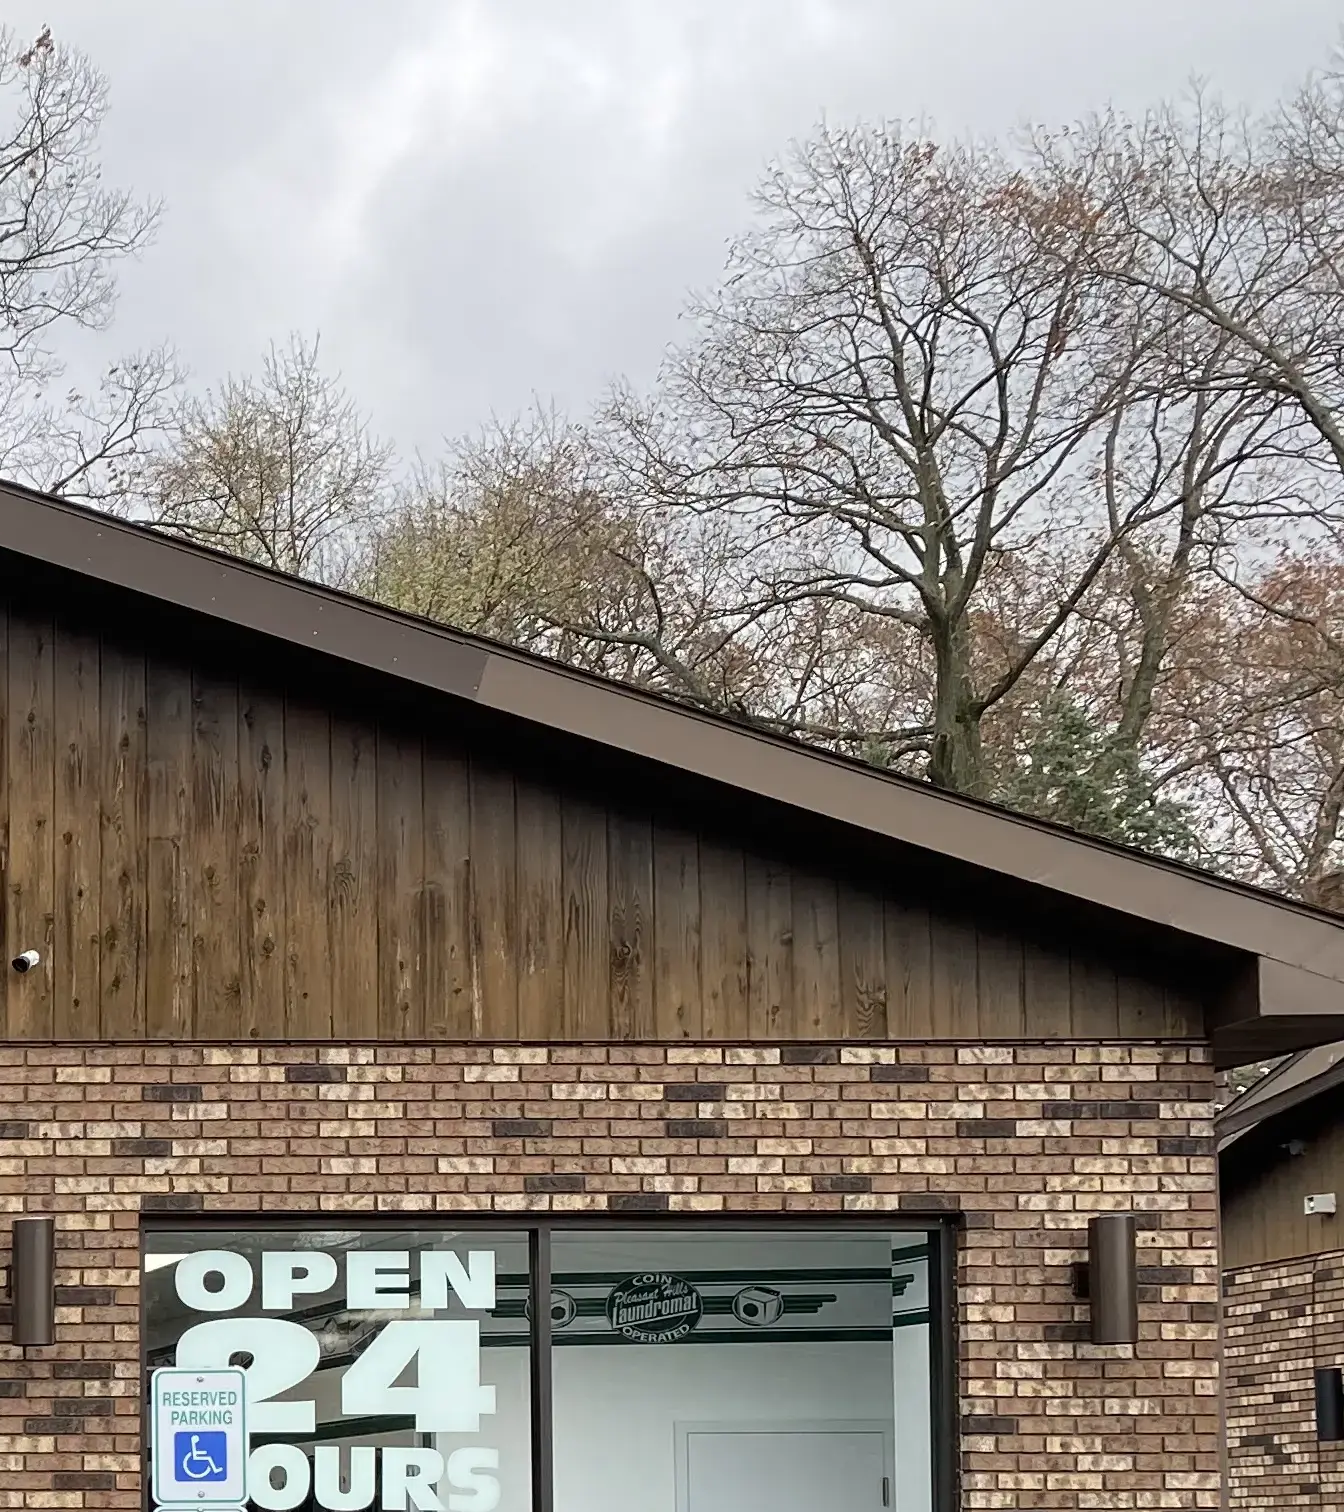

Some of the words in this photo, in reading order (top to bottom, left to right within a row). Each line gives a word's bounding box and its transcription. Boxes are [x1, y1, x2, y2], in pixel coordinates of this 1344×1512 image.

[175, 1250, 495, 1311] OPEN
[632, 1274, 672, 1286] COIN
[613, 1292, 698, 1328] Laundromat
[622, 1326, 690, 1343] OPERATED
[175, 1318, 496, 1432] 24
[162, 1391, 238, 1407] RESERVED
[171, 1410, 233, 1426] PARKING
